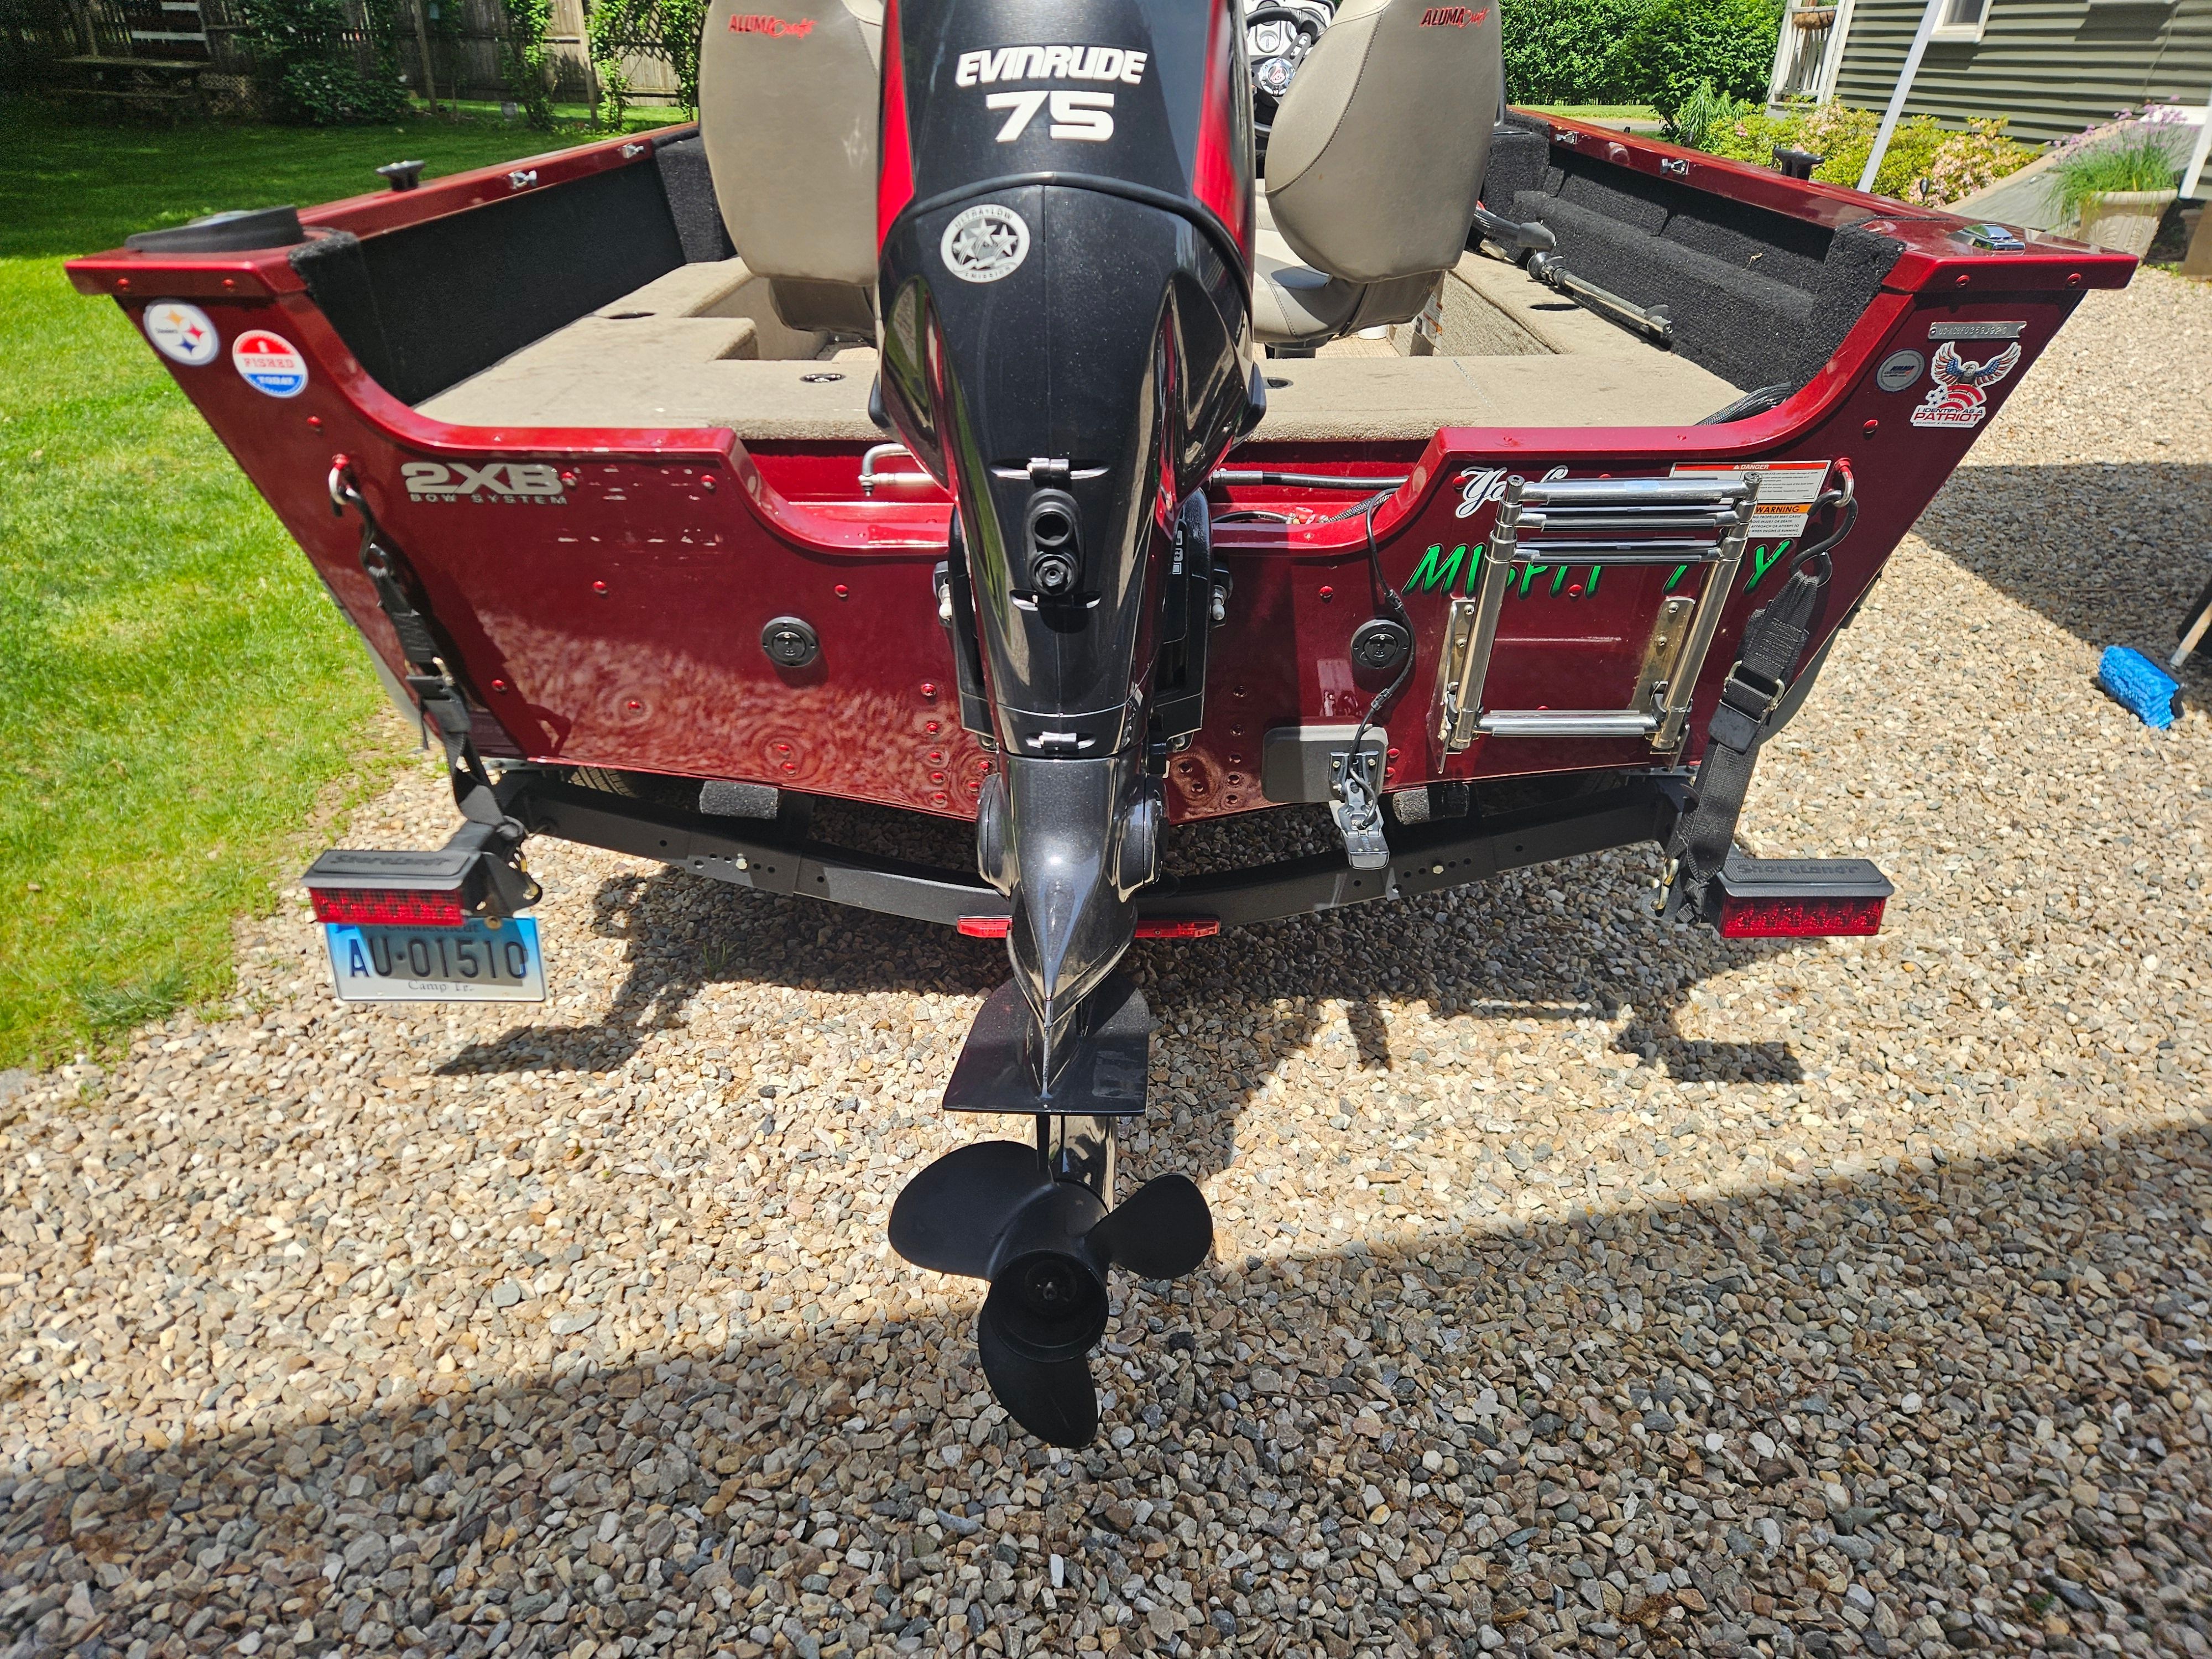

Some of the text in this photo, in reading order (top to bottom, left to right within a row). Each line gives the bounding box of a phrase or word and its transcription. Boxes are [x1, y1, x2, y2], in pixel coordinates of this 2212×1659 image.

[955, 45, 1148, 87] EVINRUDE
[986, 90, 1114, 142] 75
[243, 358, 294, 368] FISHED
[1913, 413, 1983, 421] PATRIOT
[401, 462, 564, 495] 2XB
[410, 493, 567, 504] BOW SYSTEM
[408, 979, 446, 993] Camp
